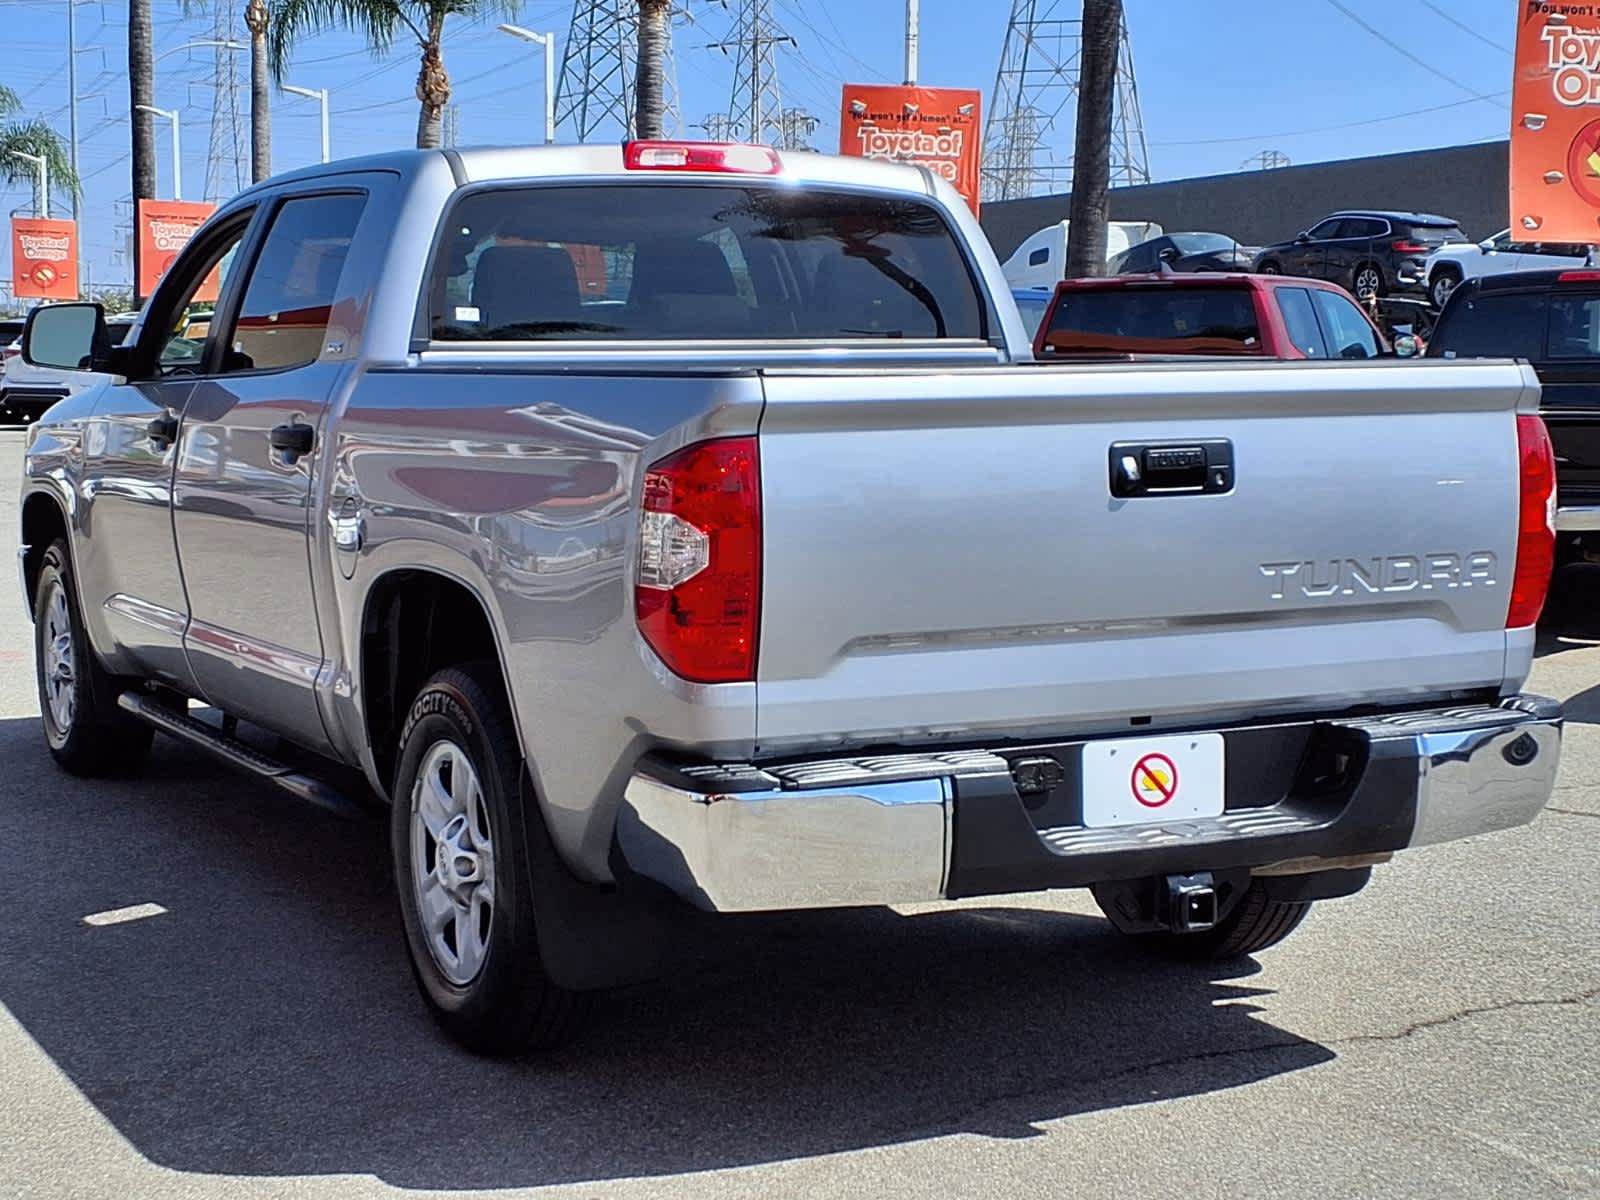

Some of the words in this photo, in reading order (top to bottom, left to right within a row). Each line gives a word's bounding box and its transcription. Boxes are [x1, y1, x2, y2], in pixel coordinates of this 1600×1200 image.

[1561, 5, 1595, 16] won't
[1540, 25, 1600, 70] Toy
[1553, 65, 1600, 107] Or
[857, 127, 937, 157] Toyota
[936, 130, 962, 157] of
[1260, 551, 1497, 599] TUNDRA
[399, 691, 450, 750] VELOCITY
